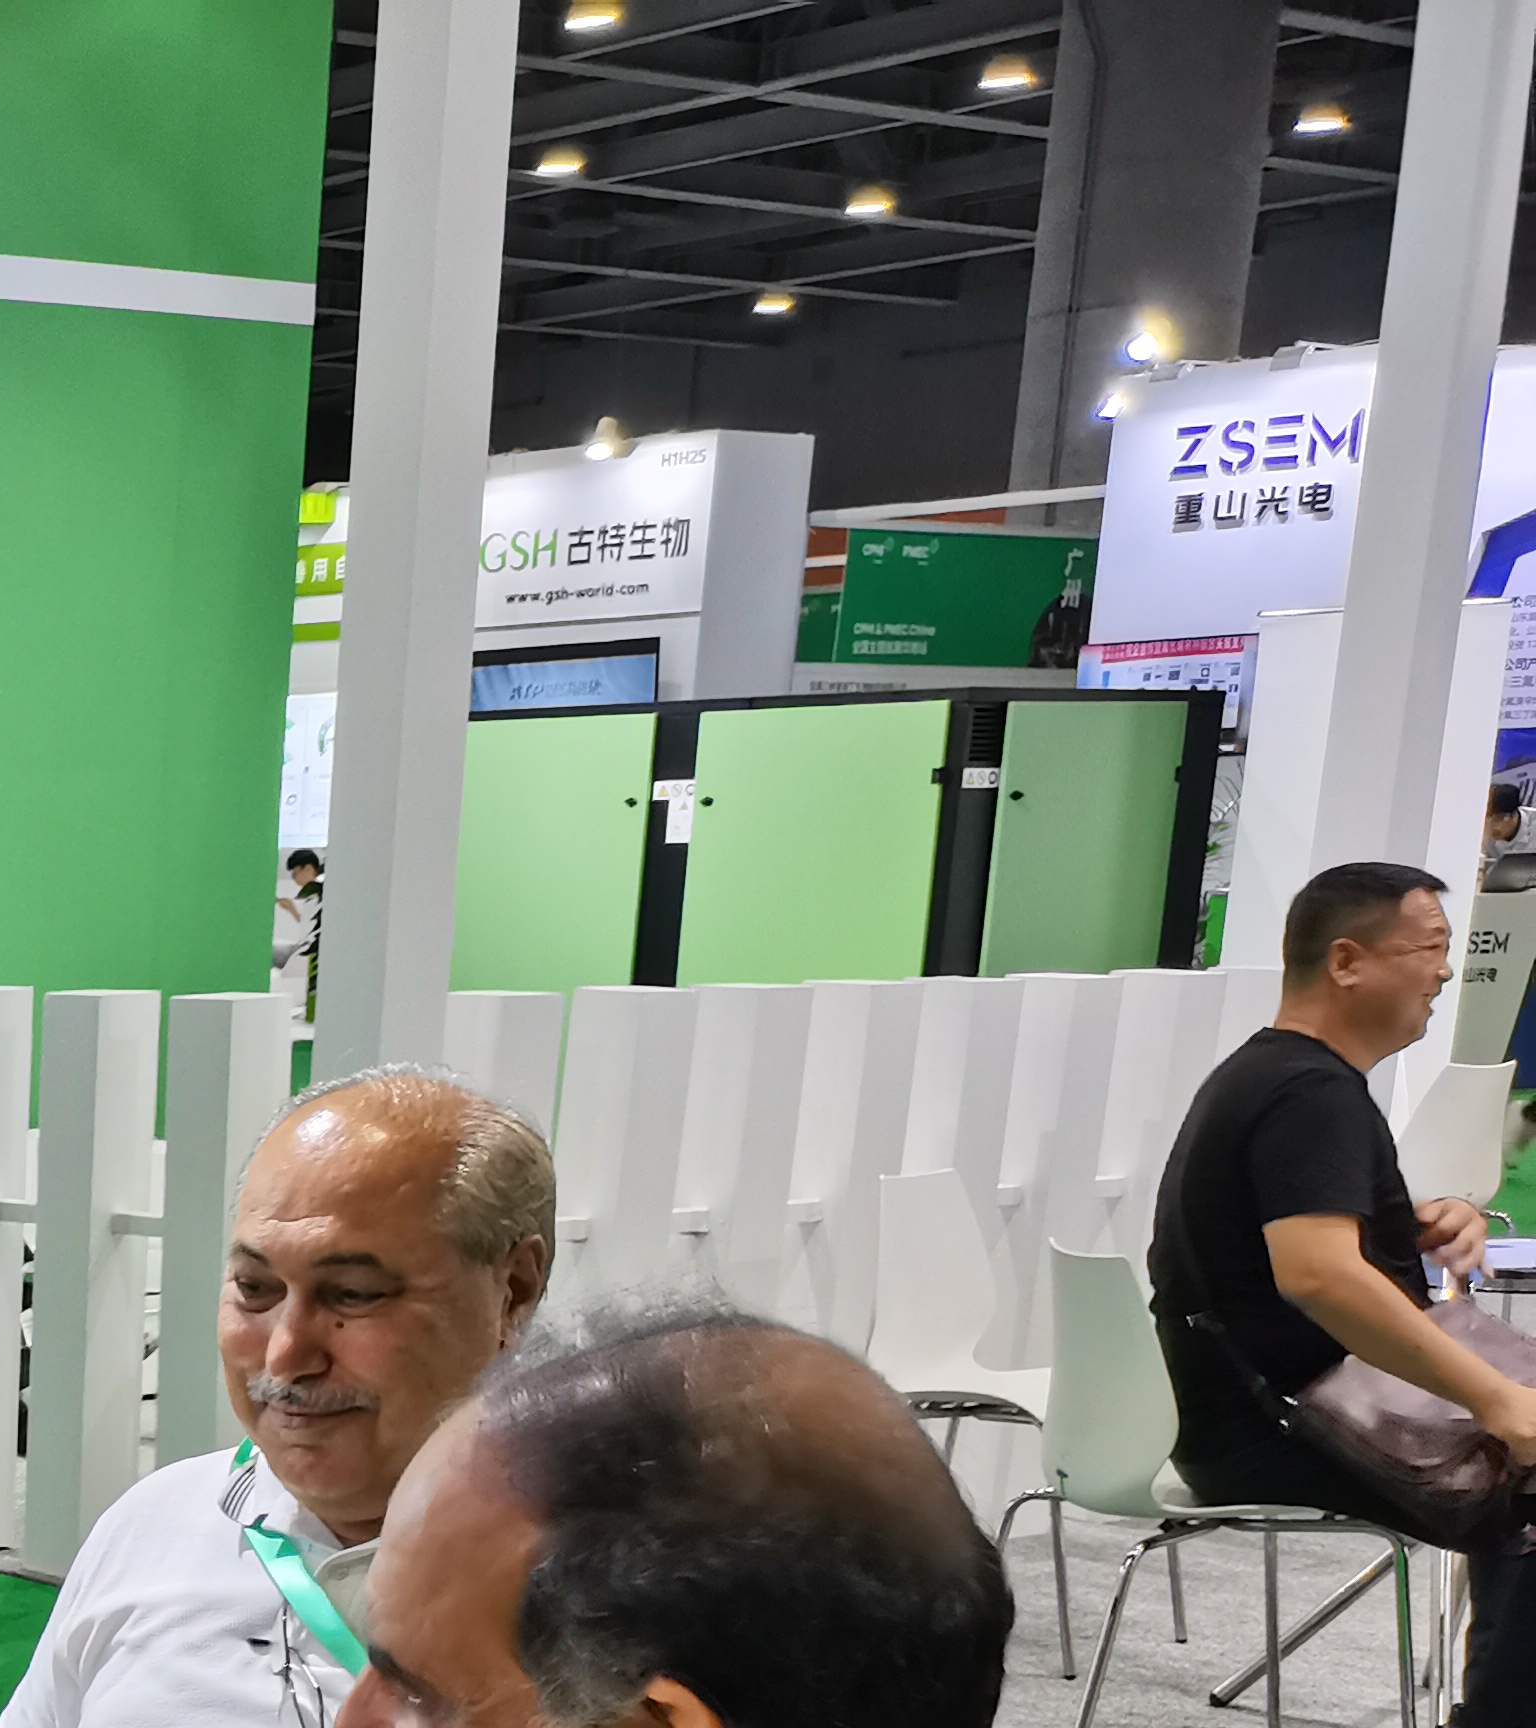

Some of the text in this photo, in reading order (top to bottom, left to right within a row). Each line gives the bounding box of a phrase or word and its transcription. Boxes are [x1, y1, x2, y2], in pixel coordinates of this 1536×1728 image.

[1169, 408, 1366, 480] ZSEM
[1172, 481, 1335, 530] 重山光电
[479, 517, 691, 573] GSH 古特生物
[505, 581, 650, 605] www.gsh-world.com
